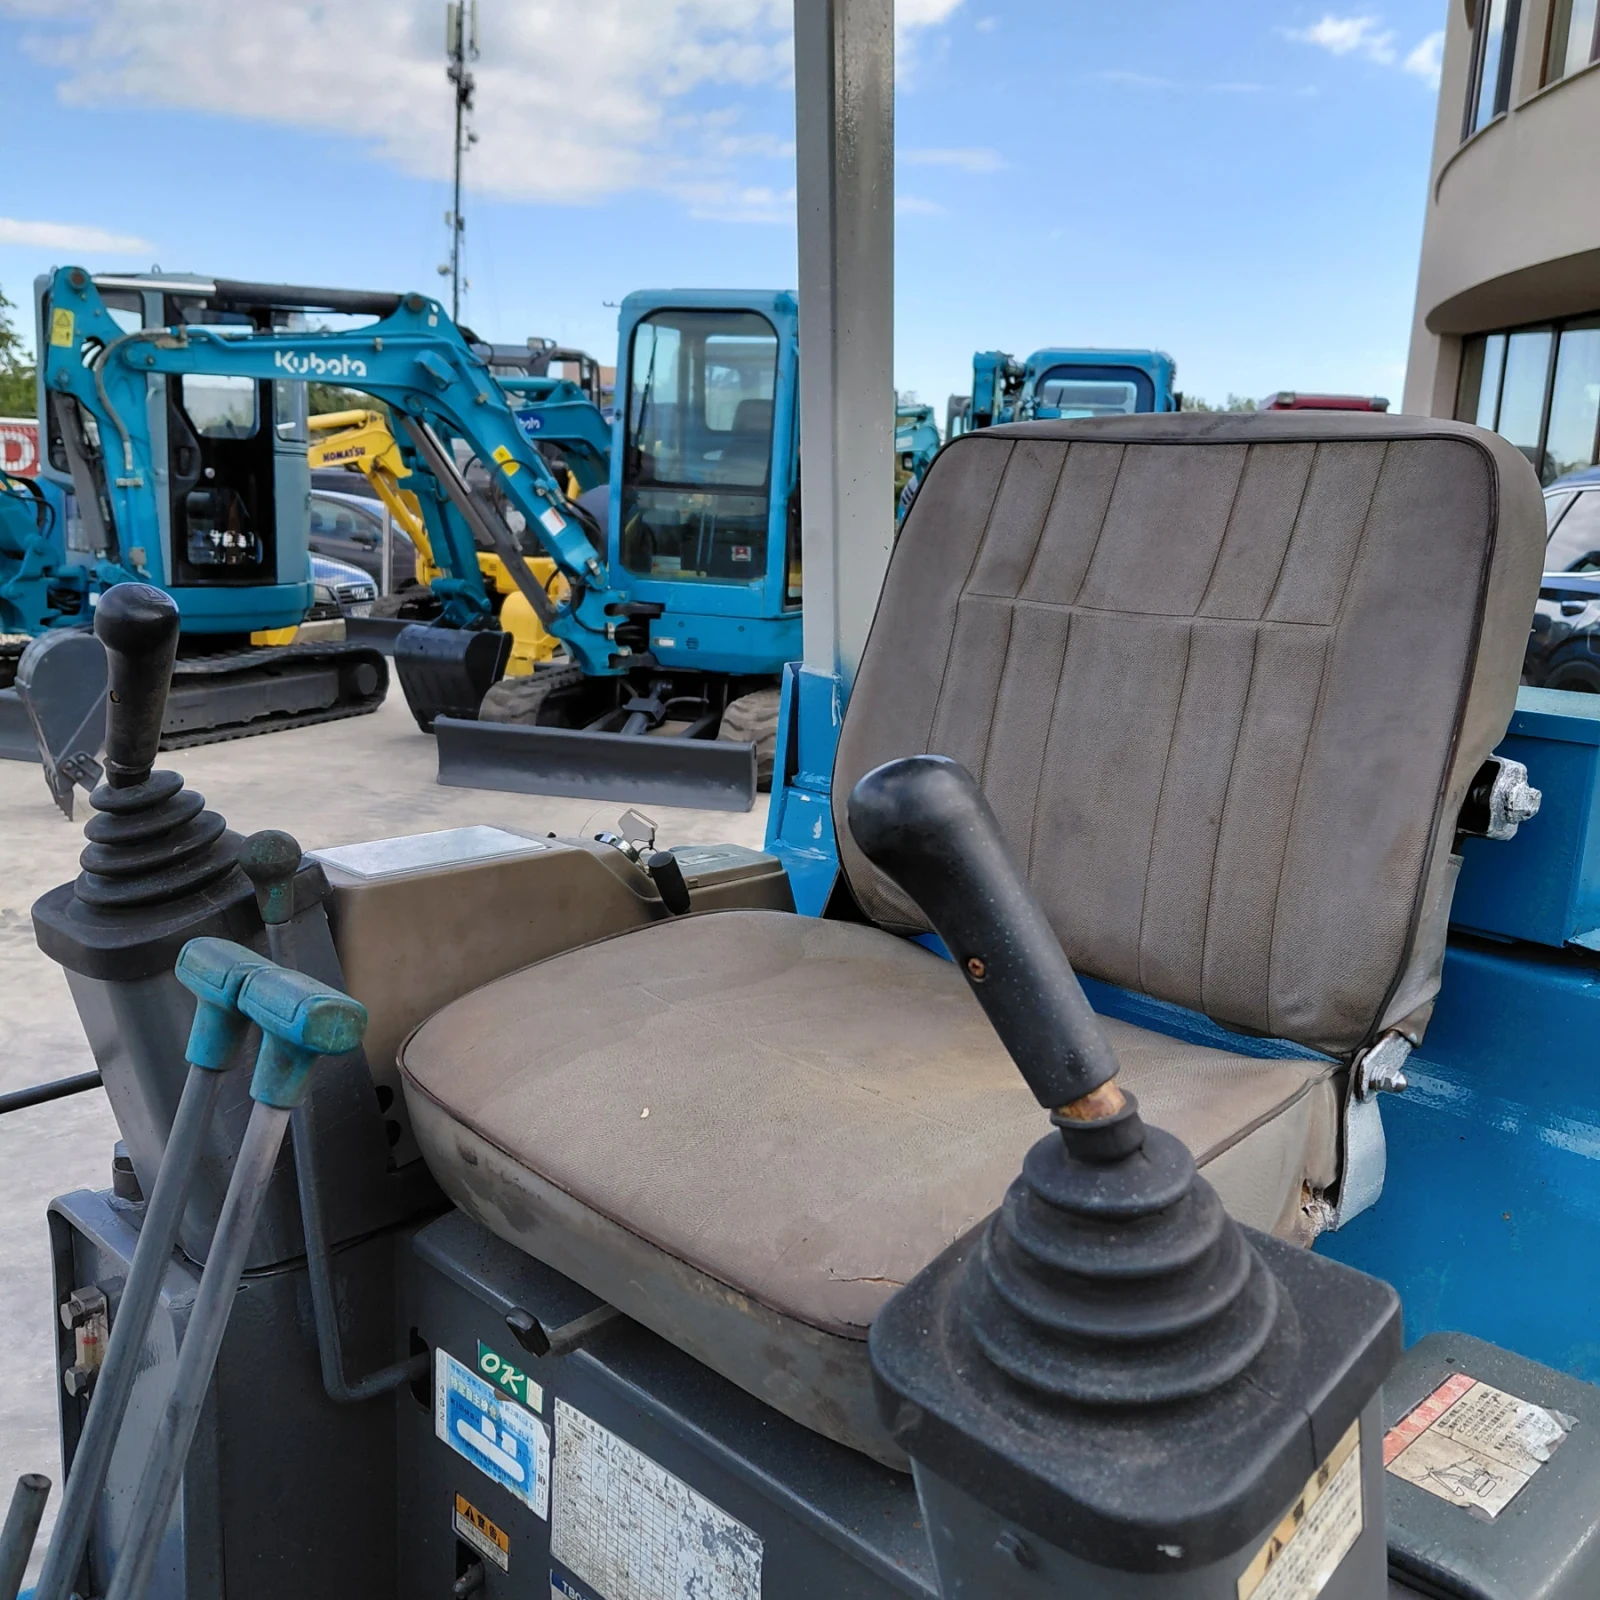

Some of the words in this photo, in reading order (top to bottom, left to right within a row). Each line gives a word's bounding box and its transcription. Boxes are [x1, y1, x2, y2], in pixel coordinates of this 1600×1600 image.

[274, 350, 367, 377] Kubota
[323, 445, 366, 462] KOMATSU
[480, 1352, 525, 1395] OK
[439, 1411, 446, 1421] 2
[537, 1473, 546, 1486] 10
